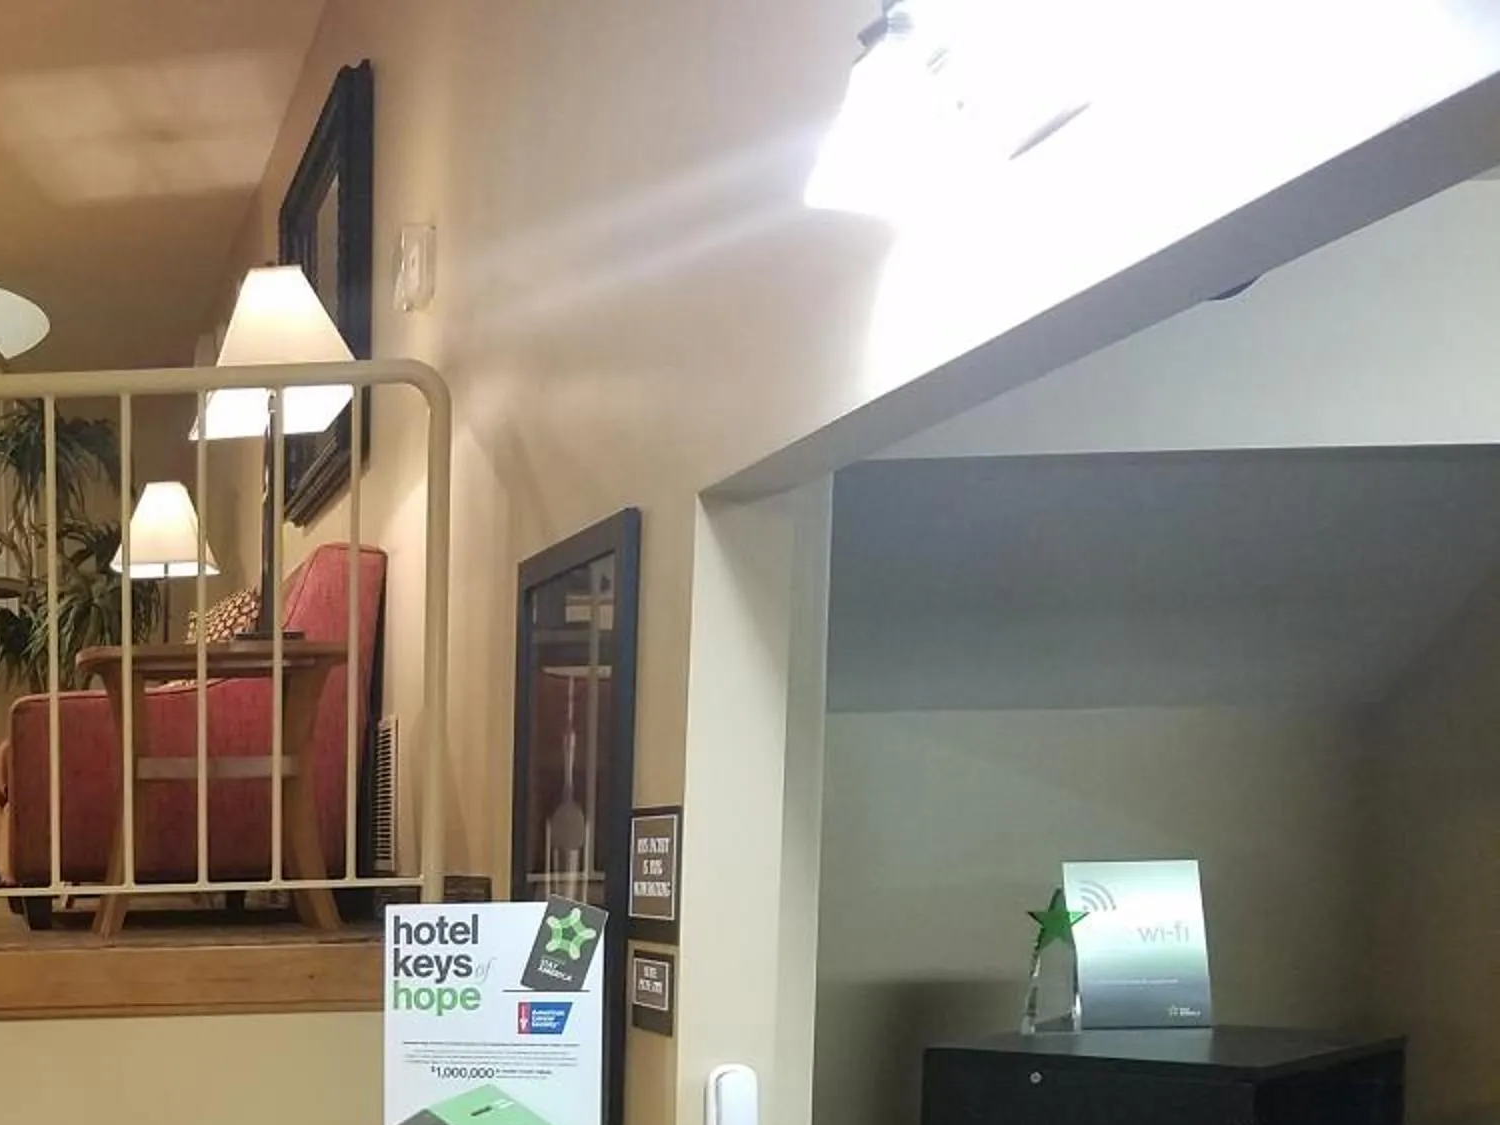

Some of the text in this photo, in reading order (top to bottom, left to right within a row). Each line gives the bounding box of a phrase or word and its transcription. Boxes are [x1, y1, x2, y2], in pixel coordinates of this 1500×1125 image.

[393, 914, 479, 945] hotel
[1136, 919, 1190, 943] wi-fi
[393, 947, 498, 985] keys of
[392, 979, 481, 1017] hope
[430, 1065, 495, 1080] $1,000,000
